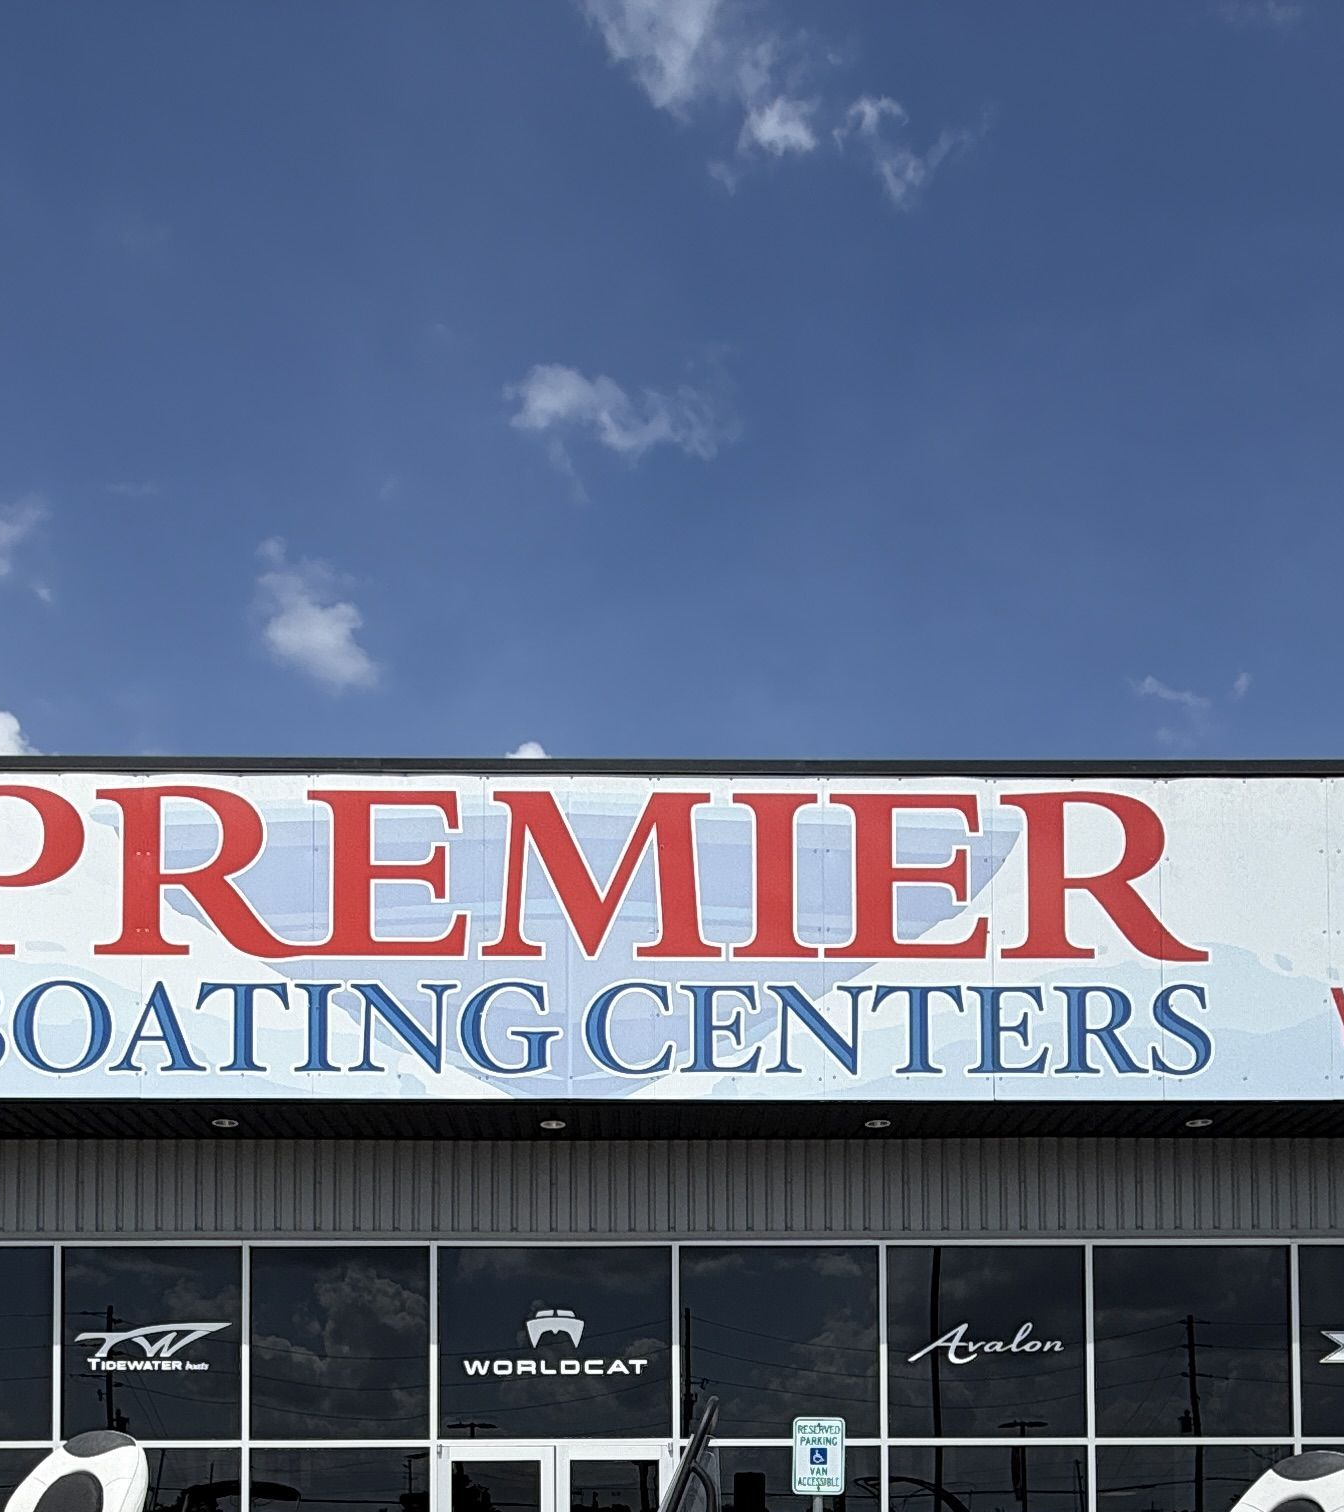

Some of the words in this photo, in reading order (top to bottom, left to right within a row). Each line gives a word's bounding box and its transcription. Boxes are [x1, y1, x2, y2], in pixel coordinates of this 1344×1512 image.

[580, 980, 1215, 1077] CENTERS
[907, 1321, 1065, 1365] Avalon
[463, 1359, 648, 1376] WORLDCAT
[797, 1424, 841, 1435] RESERVED
[800, 1436, 838, 1446] PARKING
[809, 1467, 828, 1476] VAN
[797, 1476, 840, 1487] ACCESSIBLE
